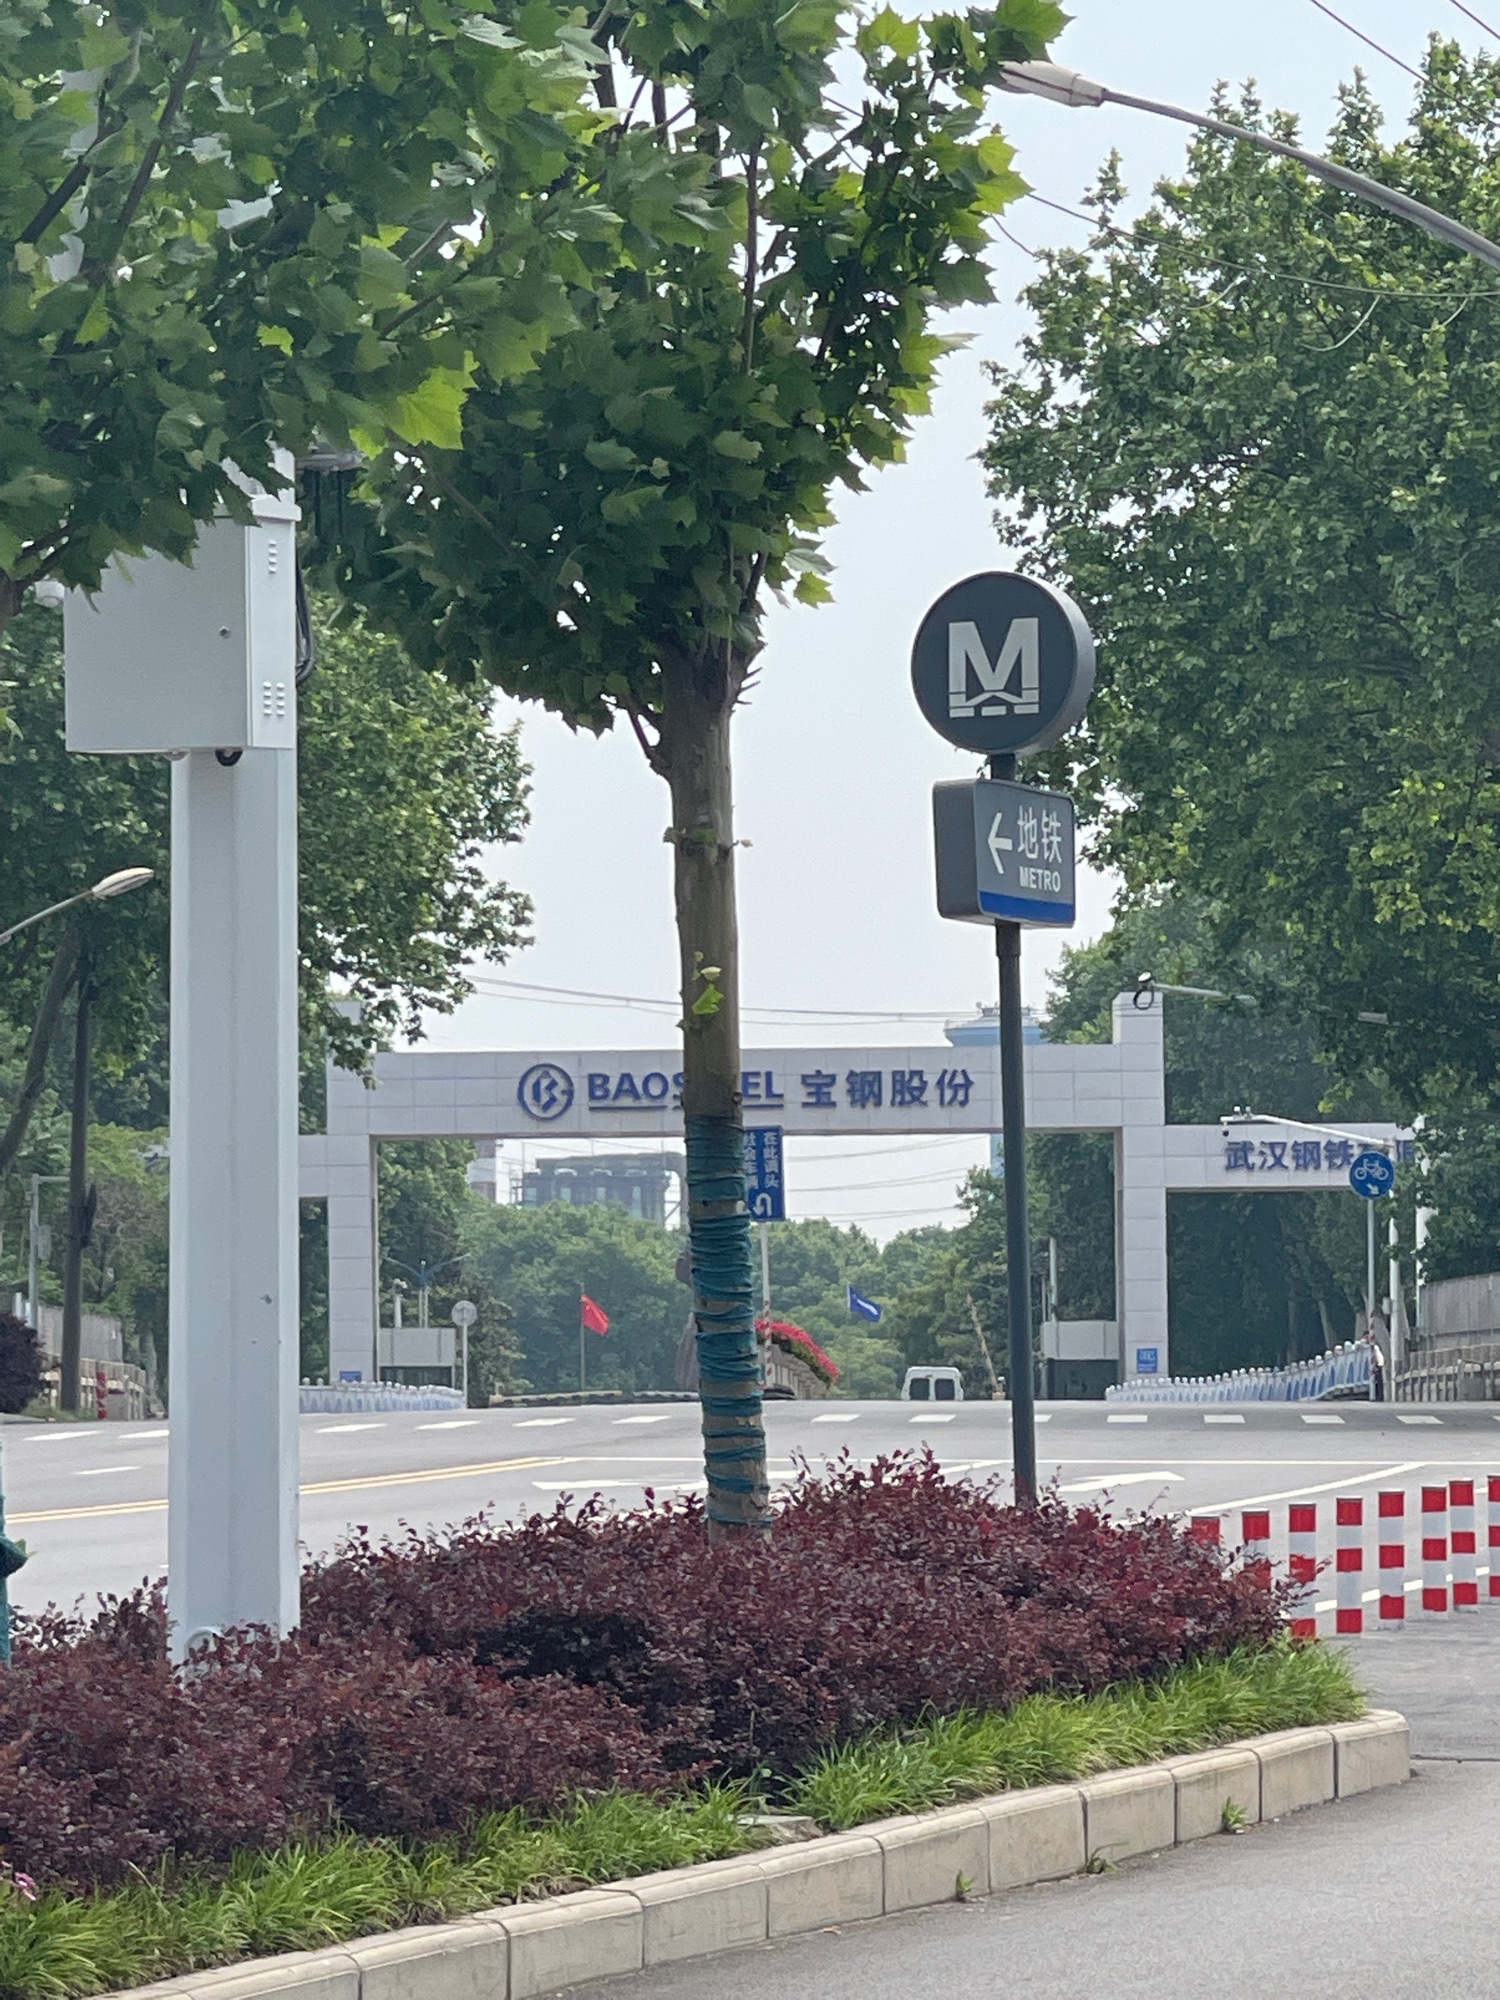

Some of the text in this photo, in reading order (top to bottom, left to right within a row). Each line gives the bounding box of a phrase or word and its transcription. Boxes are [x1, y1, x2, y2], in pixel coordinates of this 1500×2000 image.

[1017, 806, 1062, 864] 地铁
[1019, 866, 1061, 892] METRO
[588, 1069, 975, 1107] BAOSEL 宝钢股份
[1225, 1140, 1414, 1172] 武汉钢铁
